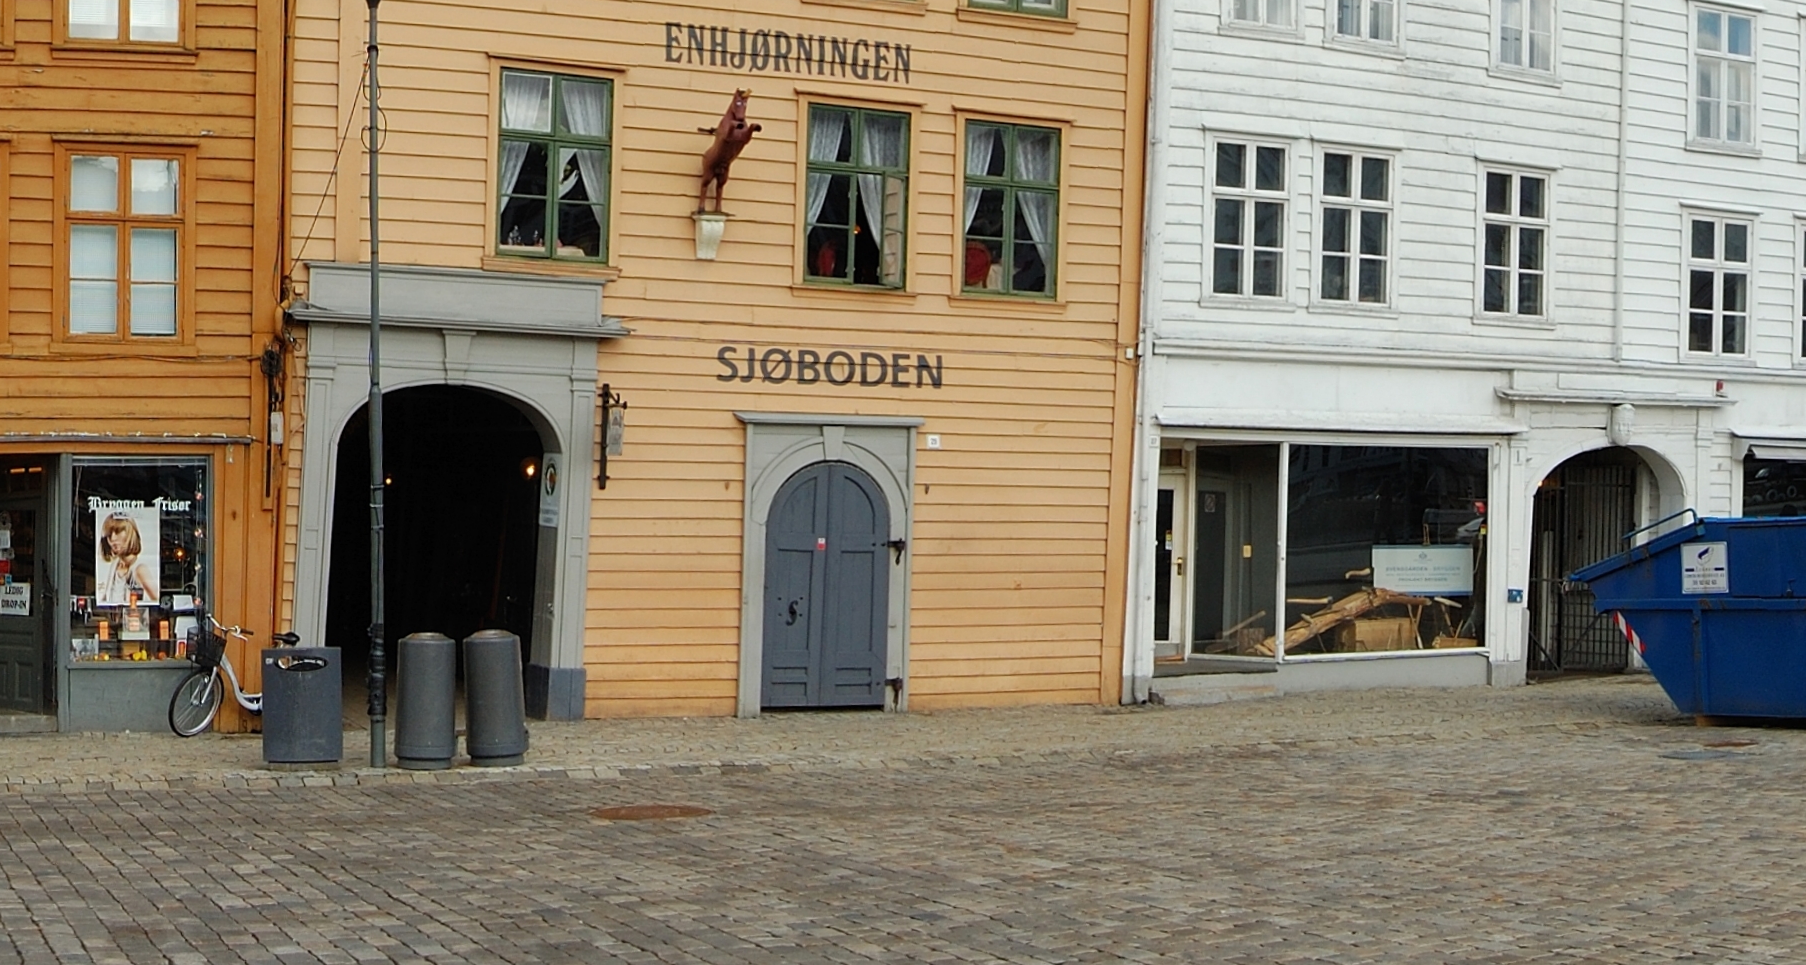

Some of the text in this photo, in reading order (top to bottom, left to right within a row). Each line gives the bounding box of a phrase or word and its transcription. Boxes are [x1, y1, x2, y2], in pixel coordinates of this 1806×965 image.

[665, 21, 911, 85] ENHJØRNINGEN
[716, 345, 943, 389] SJØBODEN
[87, 496, 144, 513] Bryggen
[5, 585, 23, 595] LEDIG
[1, 599, 27, 610] DROP-IN
